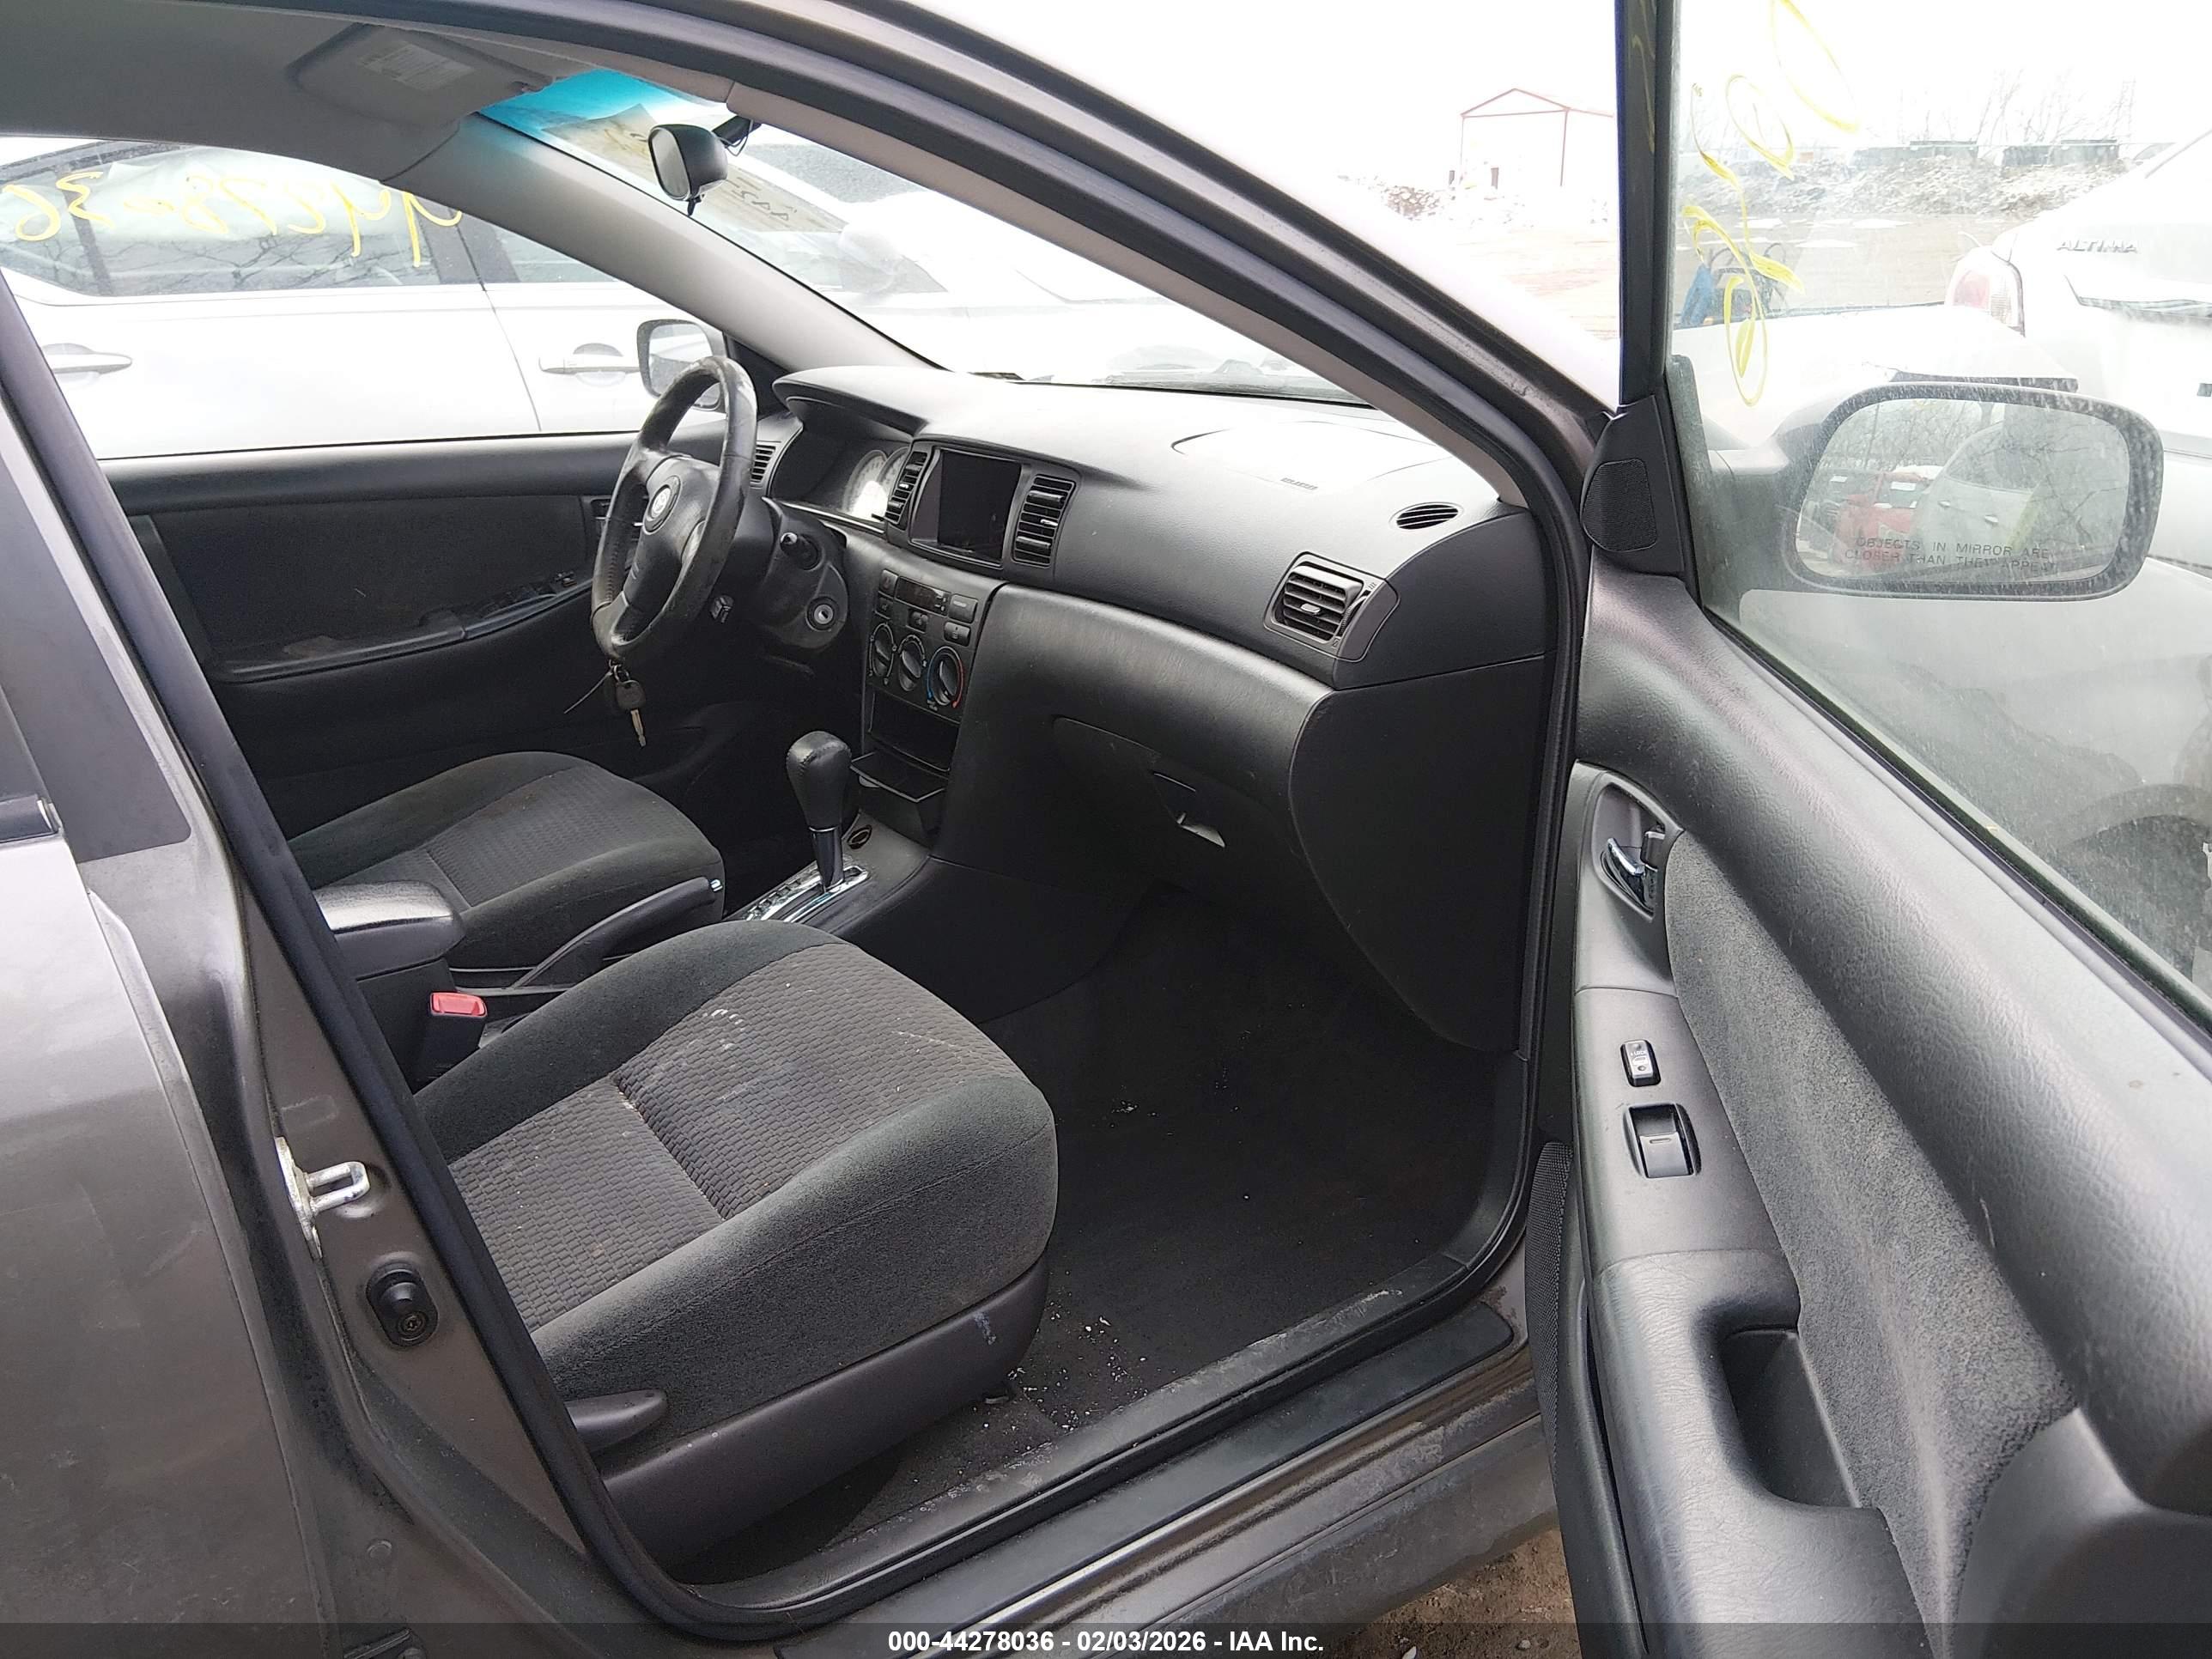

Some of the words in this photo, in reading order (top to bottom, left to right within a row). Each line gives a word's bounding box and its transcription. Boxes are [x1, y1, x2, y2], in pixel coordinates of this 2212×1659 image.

[1844, 549, 1900, 562] CLOSER
[1909, 553, 1946, 565] THAN
[1856, 537, 1921, 550] OBJECTS
[1932, 542, 1947, 552] IN
[1956, 543, 2013, 556] MIRROR
[2022, 548, 2049, 559] ARE
